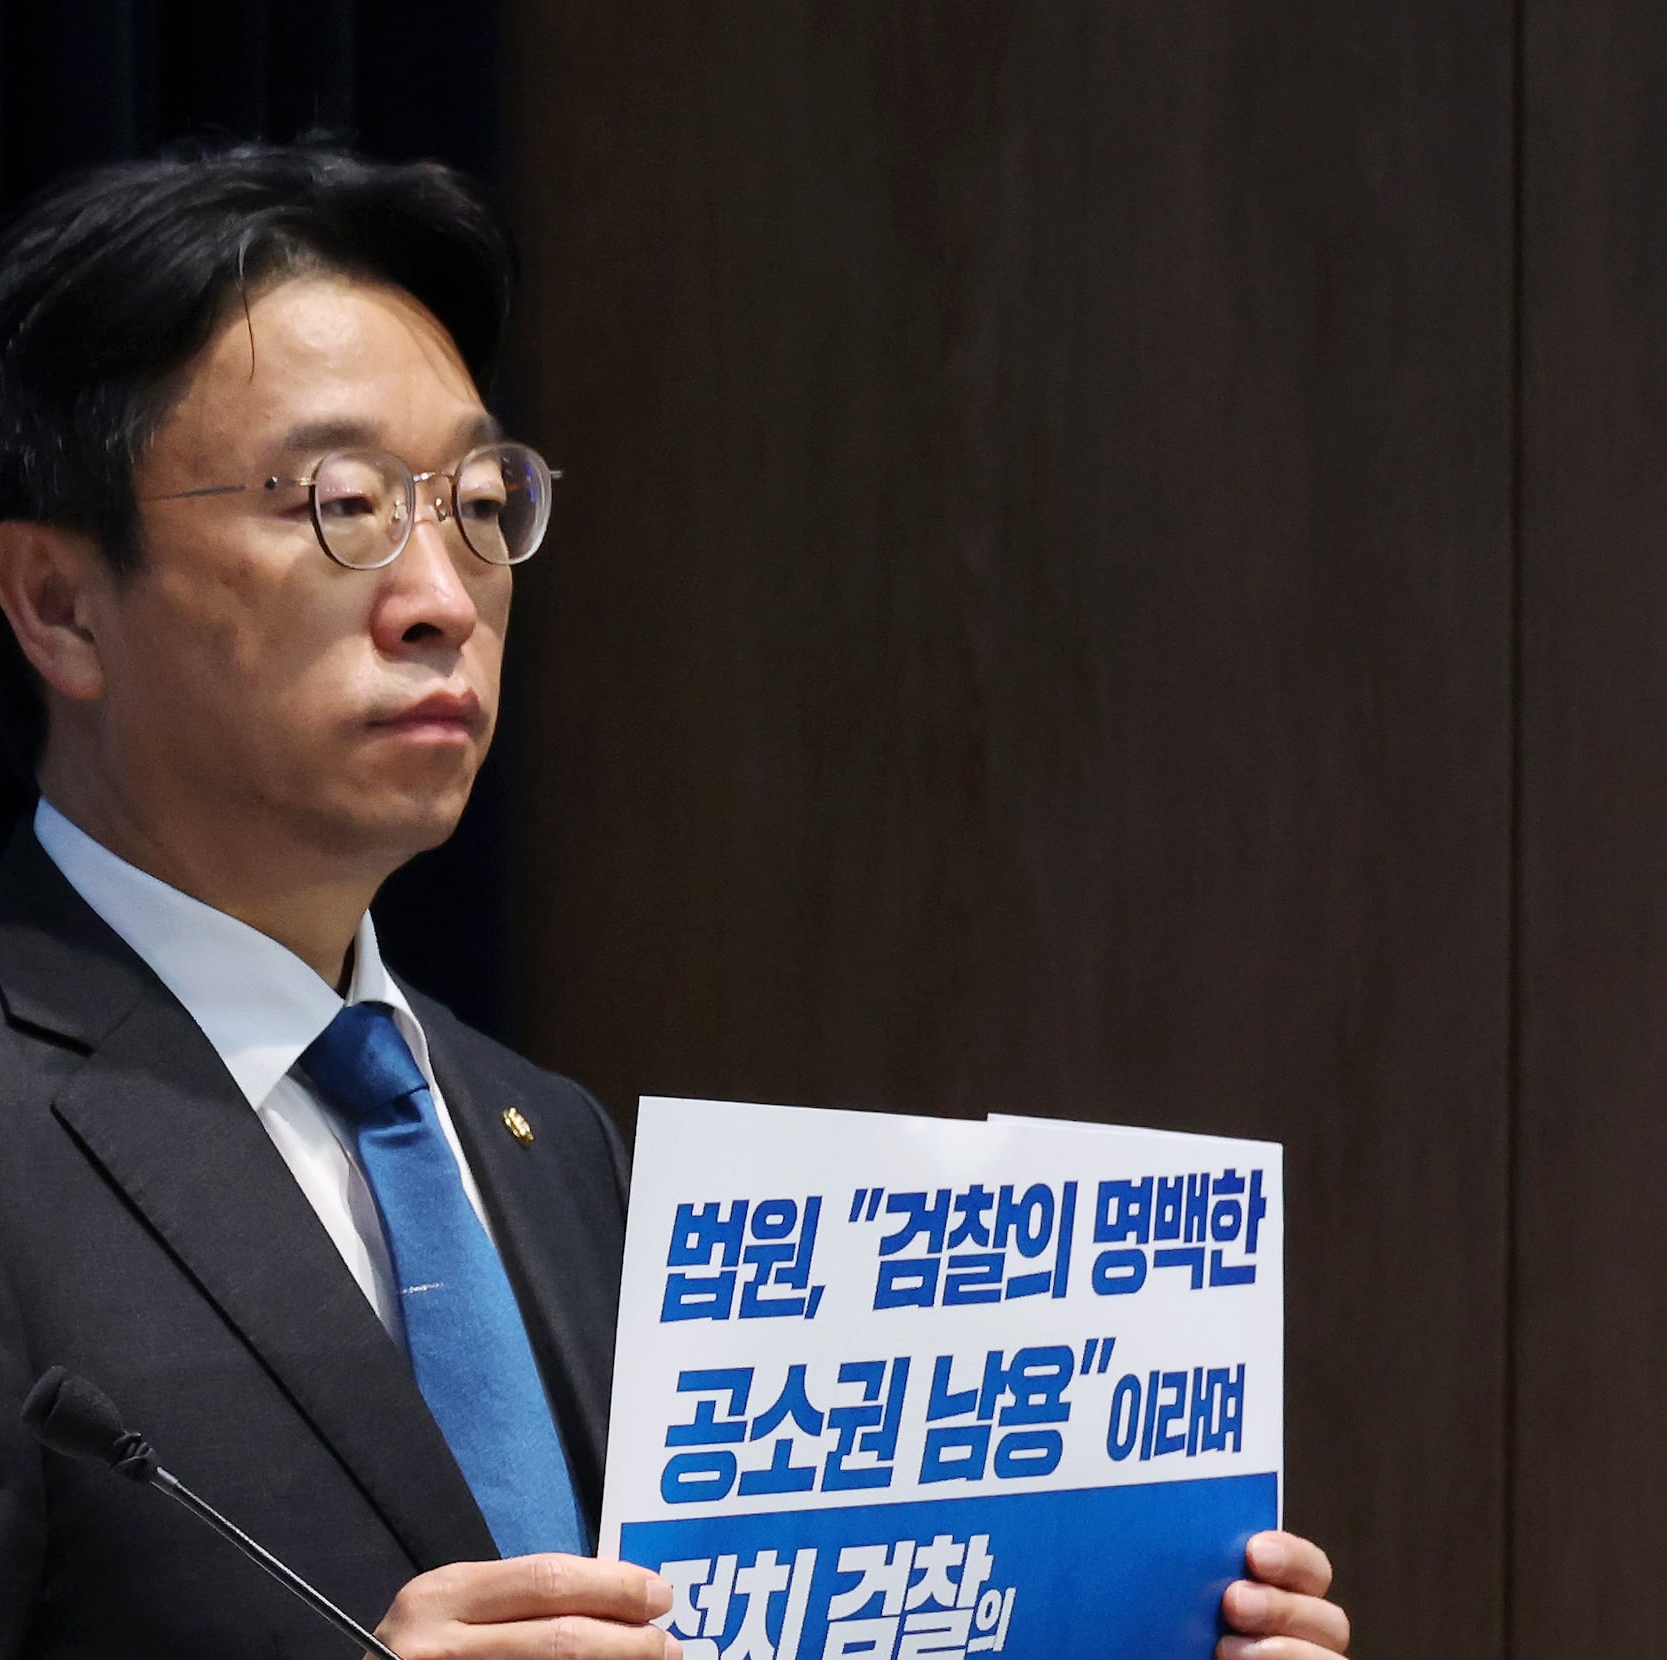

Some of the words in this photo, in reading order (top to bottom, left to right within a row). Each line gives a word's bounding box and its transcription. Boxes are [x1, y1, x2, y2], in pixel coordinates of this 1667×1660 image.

[659, 1195, 828, 1324] 법원,
[1091, 1168, 1267, 1297] 명백한
[659, 1357, 910, 1506] 공소권
